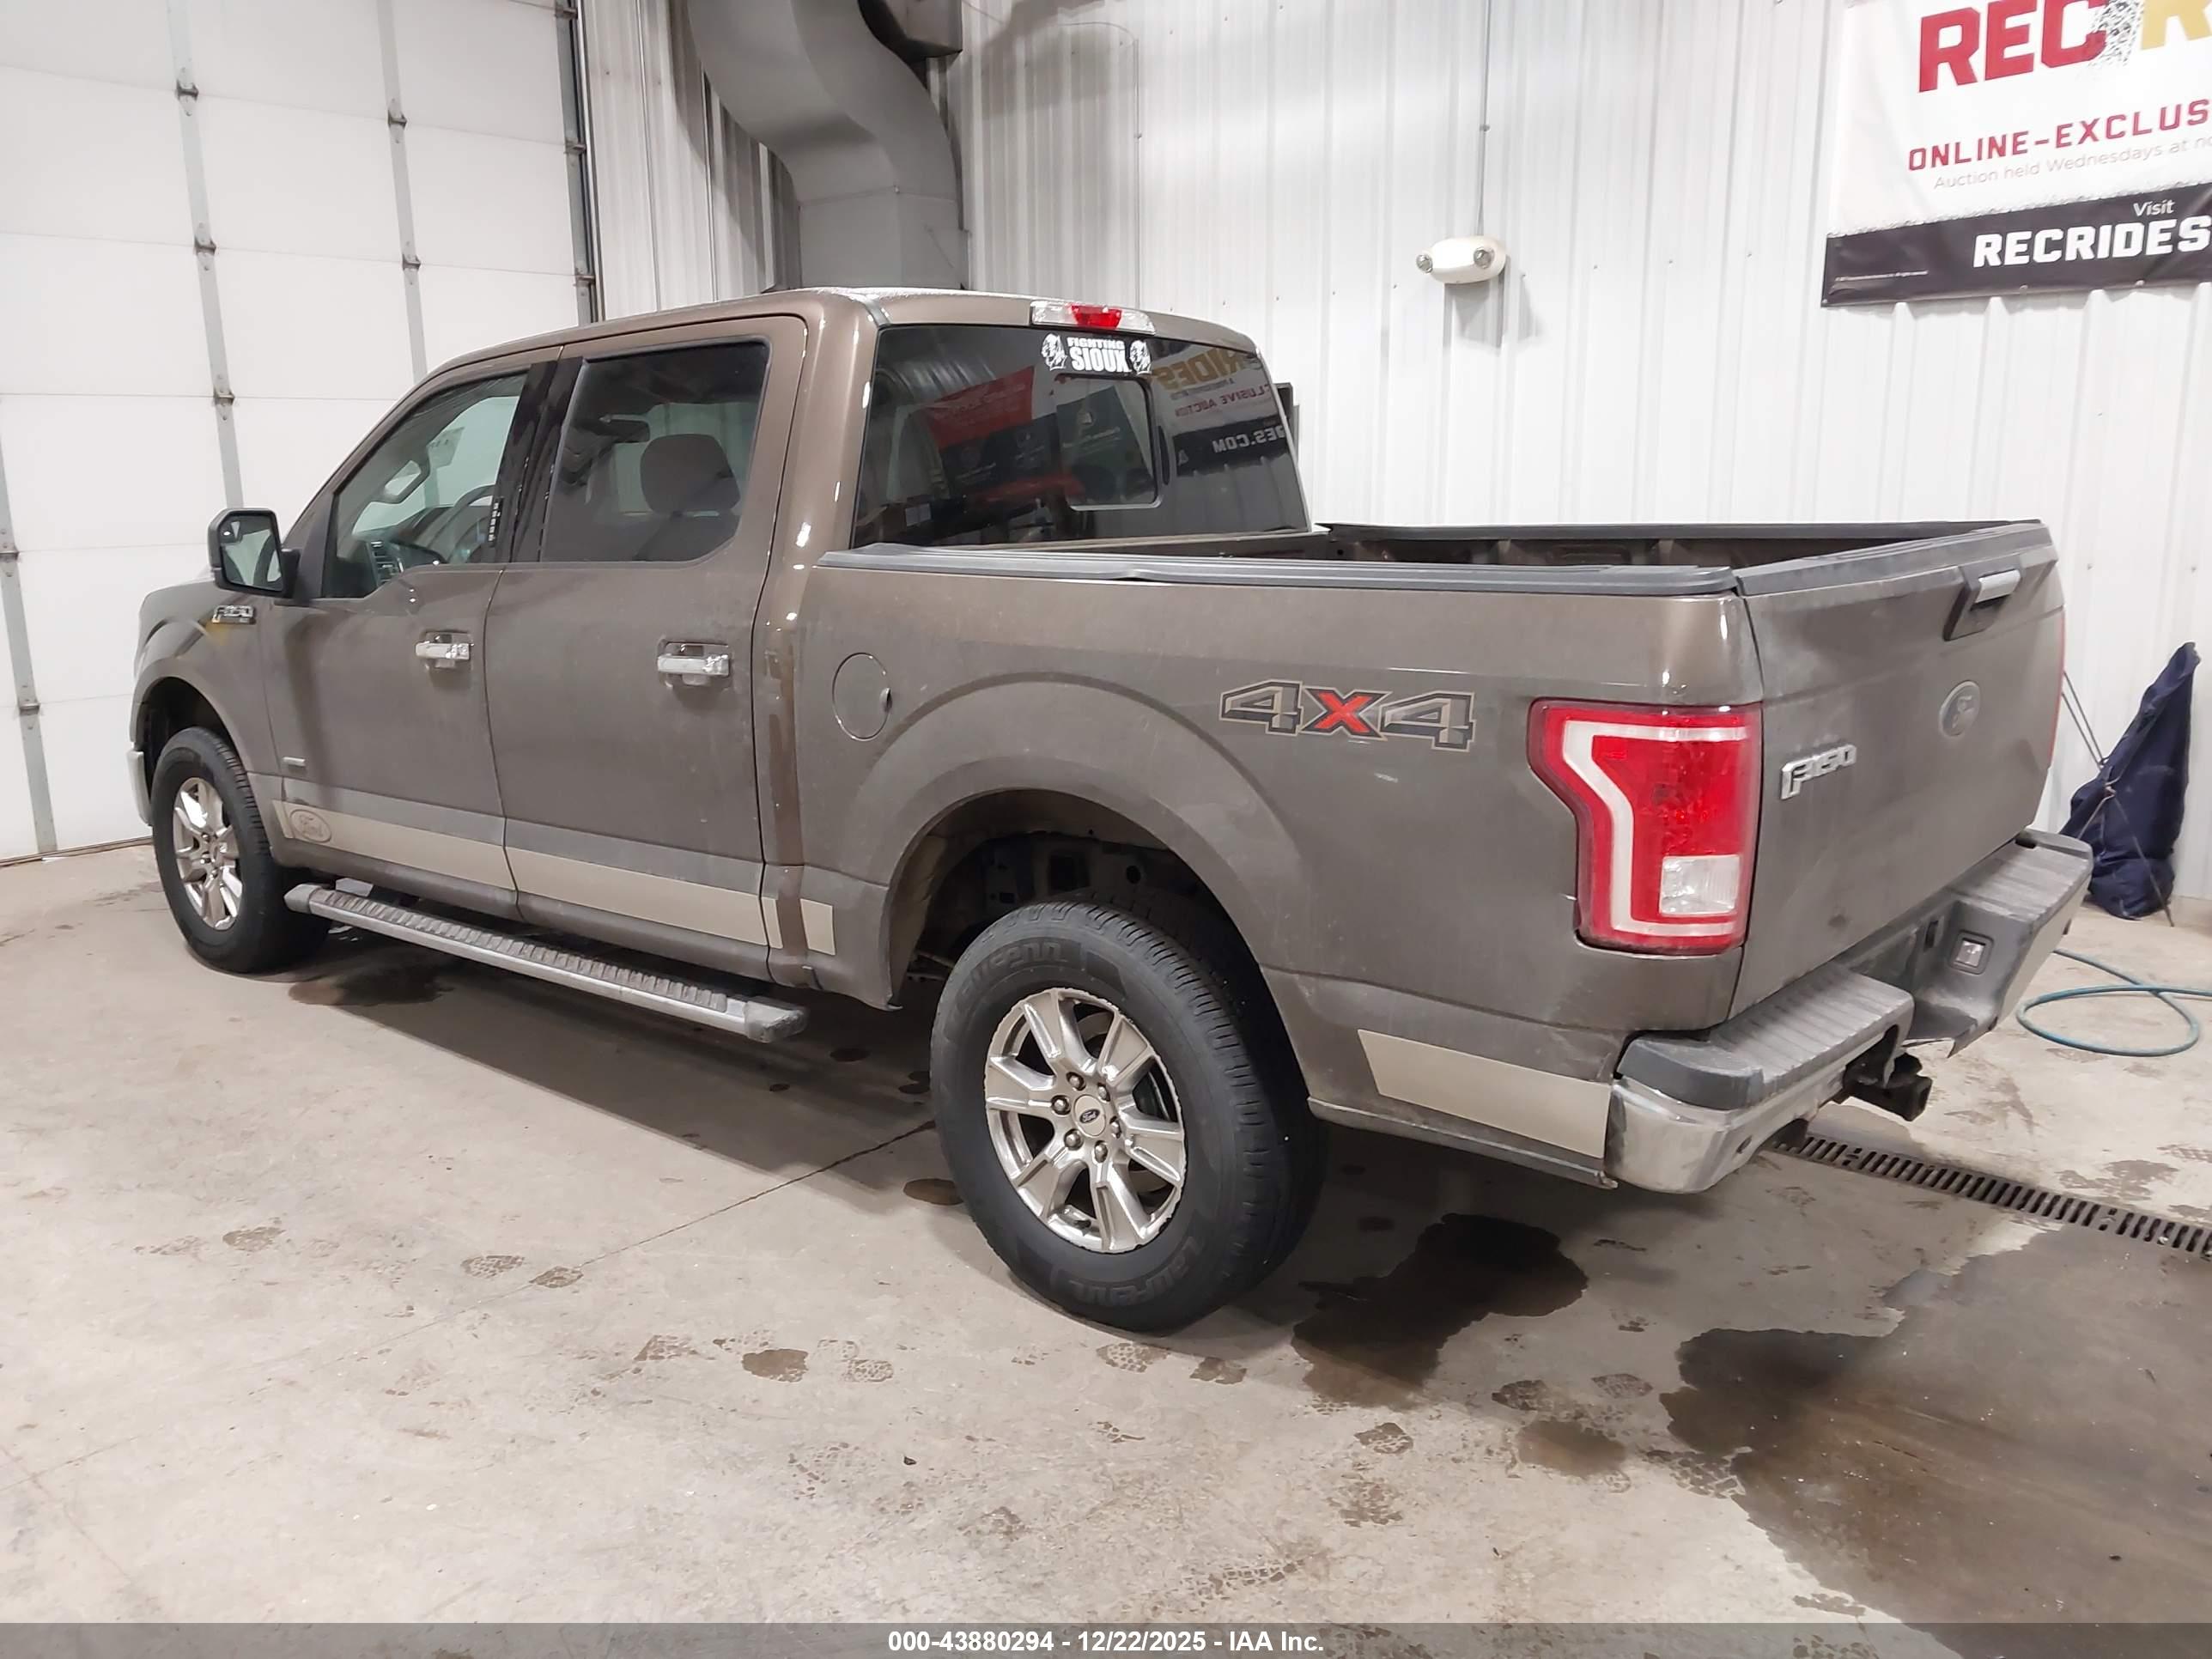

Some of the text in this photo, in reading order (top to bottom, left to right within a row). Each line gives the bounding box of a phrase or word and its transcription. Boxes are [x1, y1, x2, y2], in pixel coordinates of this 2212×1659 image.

[1908, 99, 2209, 172] ONLINE-EXCLUS
[1934, 167, 1998, 189] Auction
[2003, 161, 2040, 179] held
[2046, 144, 2163, 173] Wednesdays
[2169, 140, 2190, 154] at
[2133, 199, 2175, 217] Visit
[1973, 215, 2212, 268] RECRIDES
[1066, 337, 1125, 349] FIGHTING
[1069, 347, 1132, 373] SIOUX
